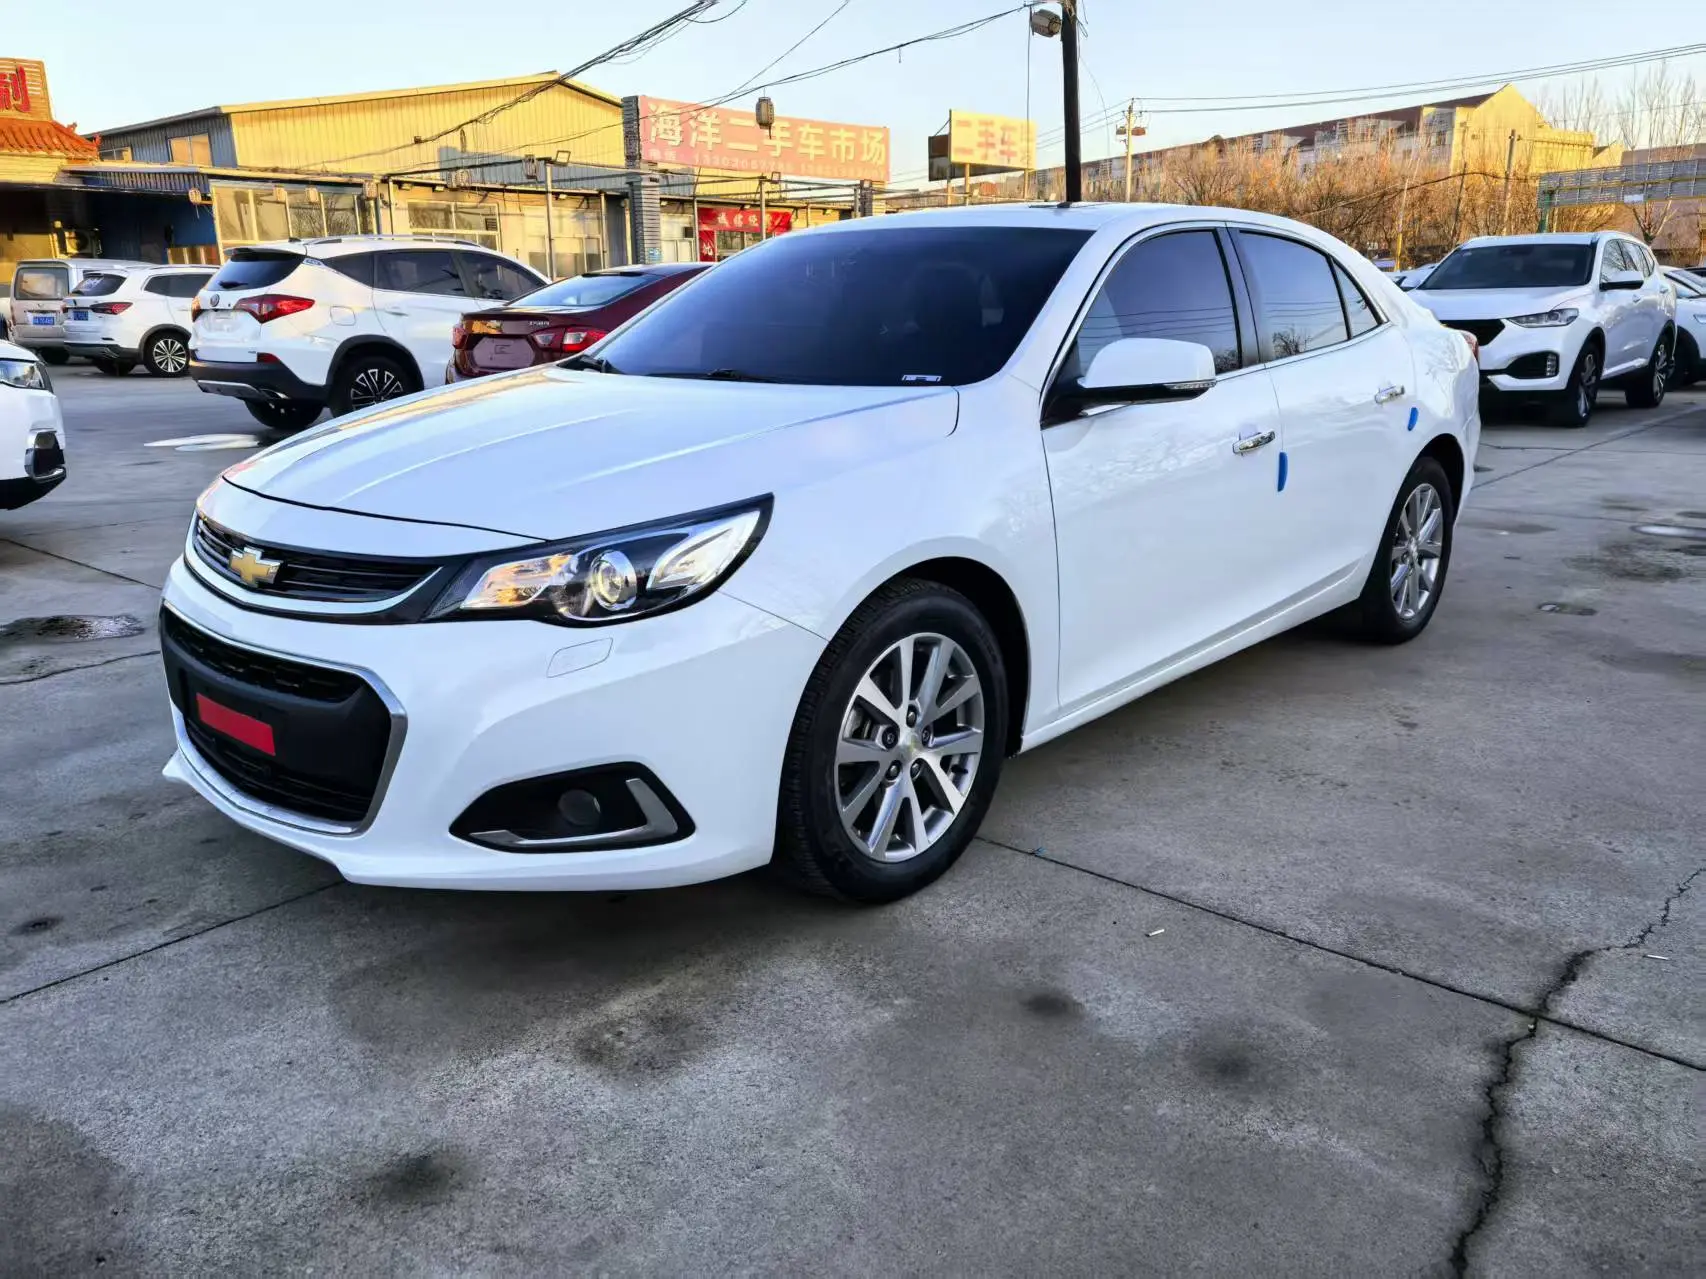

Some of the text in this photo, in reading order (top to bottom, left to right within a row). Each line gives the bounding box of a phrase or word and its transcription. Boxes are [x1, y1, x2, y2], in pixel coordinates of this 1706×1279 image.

[648, 103, 886, 167] 海洋二手车市场
[953, 118, 1018, 164] 二手车
